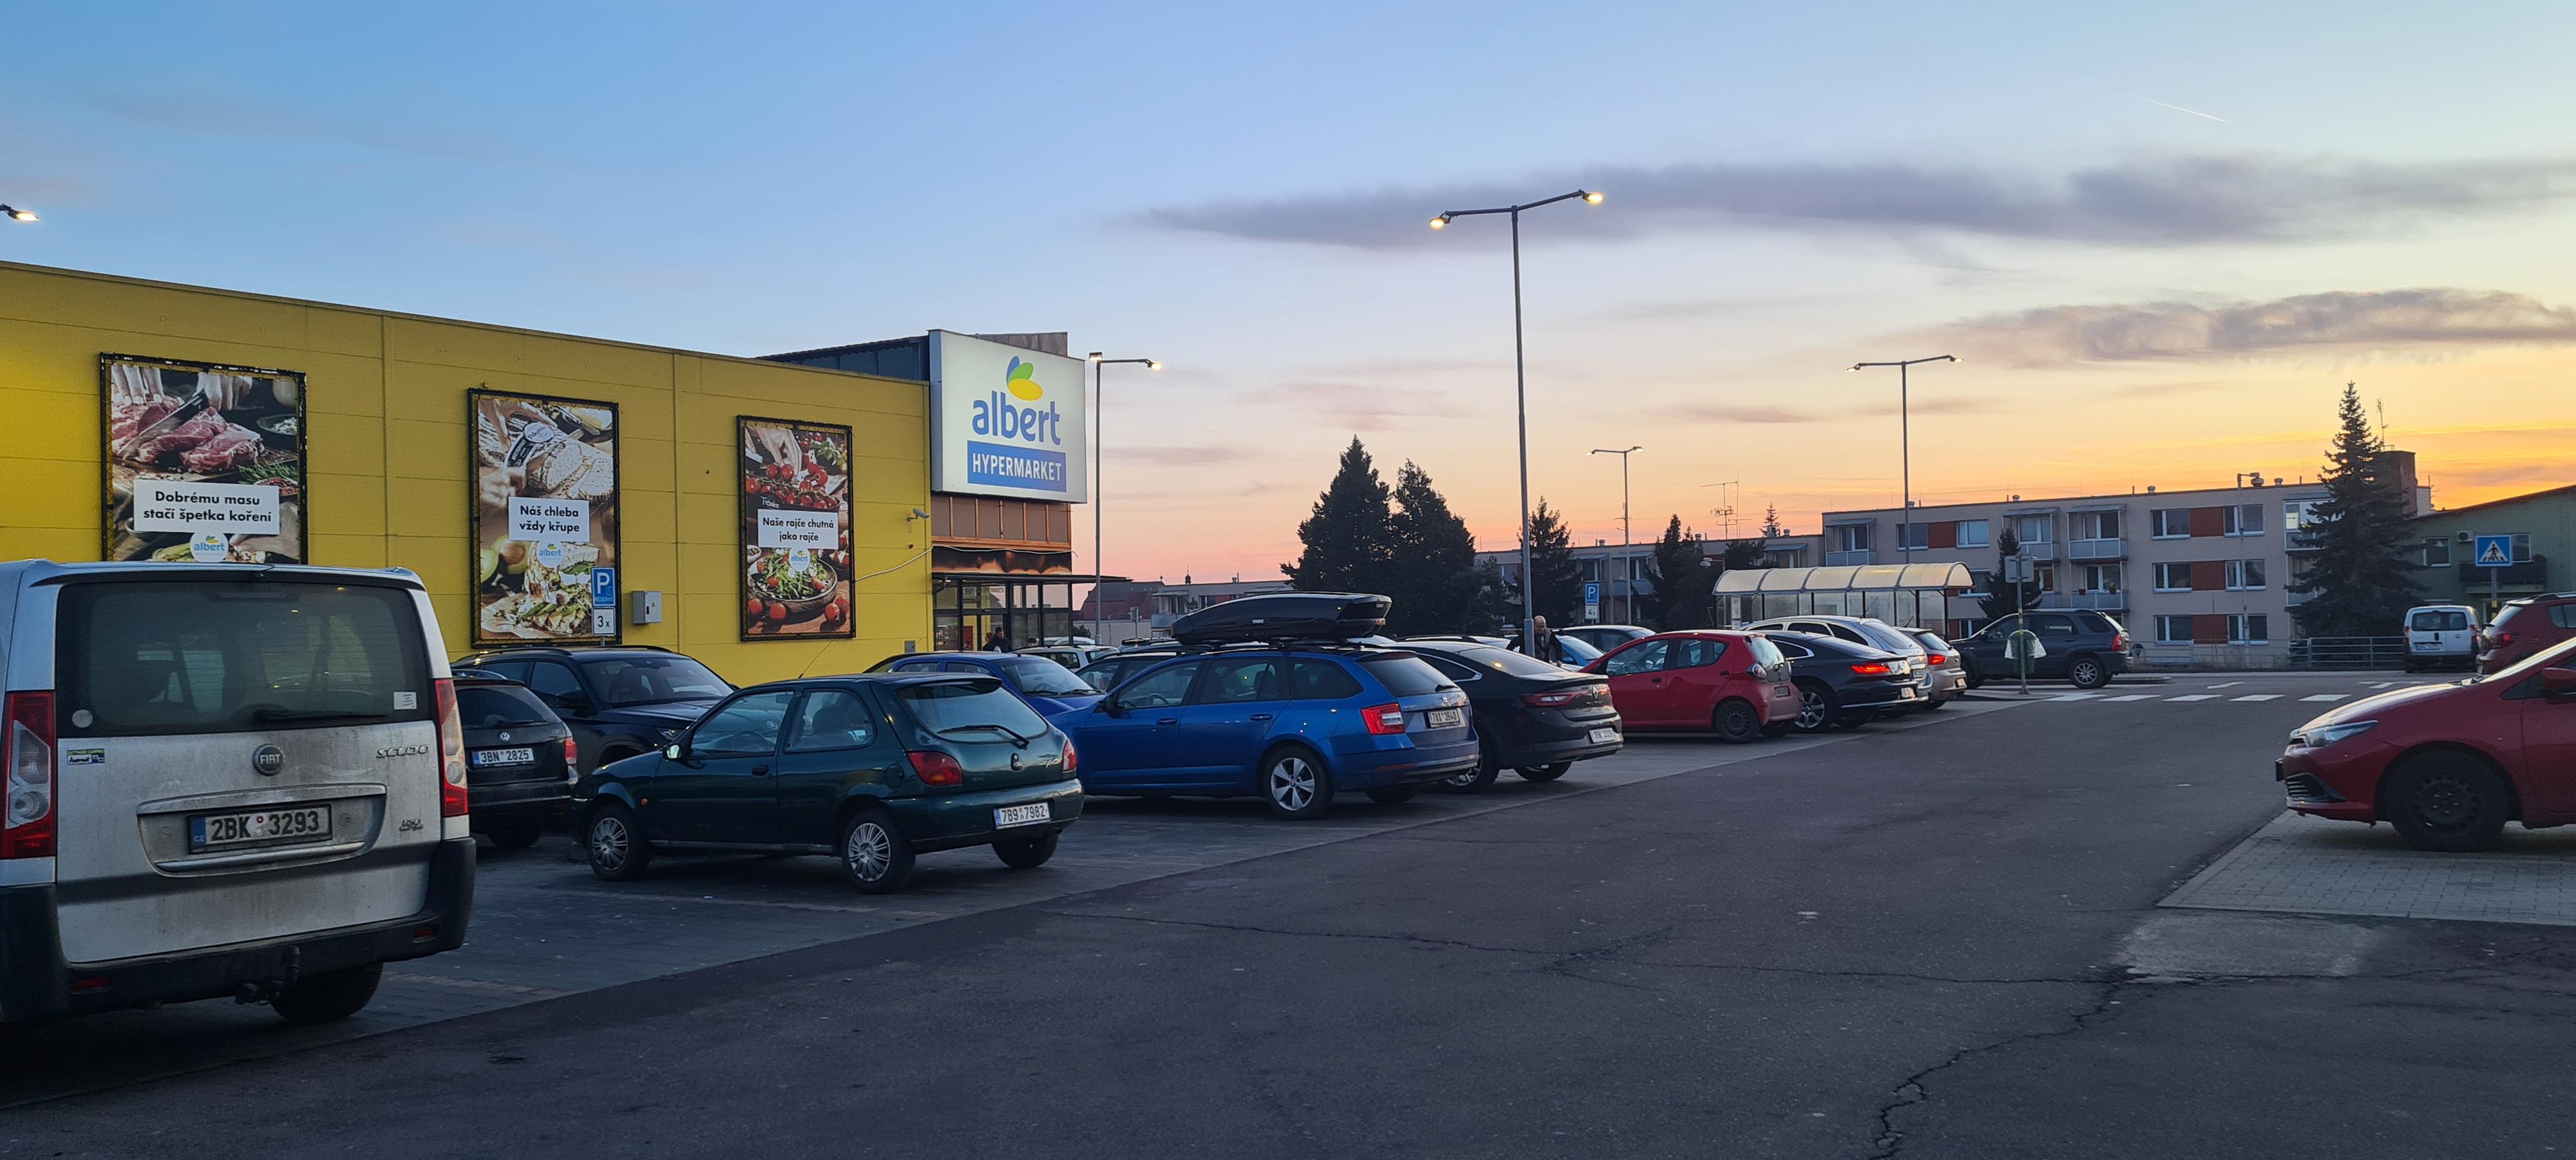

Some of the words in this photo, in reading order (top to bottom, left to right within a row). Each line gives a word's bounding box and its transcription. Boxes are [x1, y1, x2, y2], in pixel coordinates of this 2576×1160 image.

[972, 390, 1061, 446] albert
[972, 453, 1062, 482] HYPERMARKET
[155, 491, 220, 504] Dobrému
[225, 497, 260, 506] masu
[143, 508, 175, 520] stačí
[179, 508, 225, 523] špetka
[229, 510, 272, 522] koření
[520, 506, 542, 516] Náš
[544, 506, 579, 517] chleba
[519, 520, 546, 533] vždy
[549, 521, 580, 535] křupe
[762, 517, 784, 526] Naše
[786, 518, 806, 529] rajče
[808, 518, 834, 528] chutná
[779, 531, 797, 542] jako
[799, 533, 819, 543] rajče
[194, 542, 225, 551] albert
[597, 572, 610, 594] P
[1588, 587, 1596, 598] P
[376, 745, 430, 759] SCUDO
[480, 751, 500, 763] 3BN
[506, 749, 529, 761] 2825
[260, 754, 281, 765] FIAT
[1001, 809, 1019, 823] 7B9
[1024, 804, 1046, 820] 7982
[211, 816, 251, 841] 2BK
[269, 810, 319, 835] 3293
